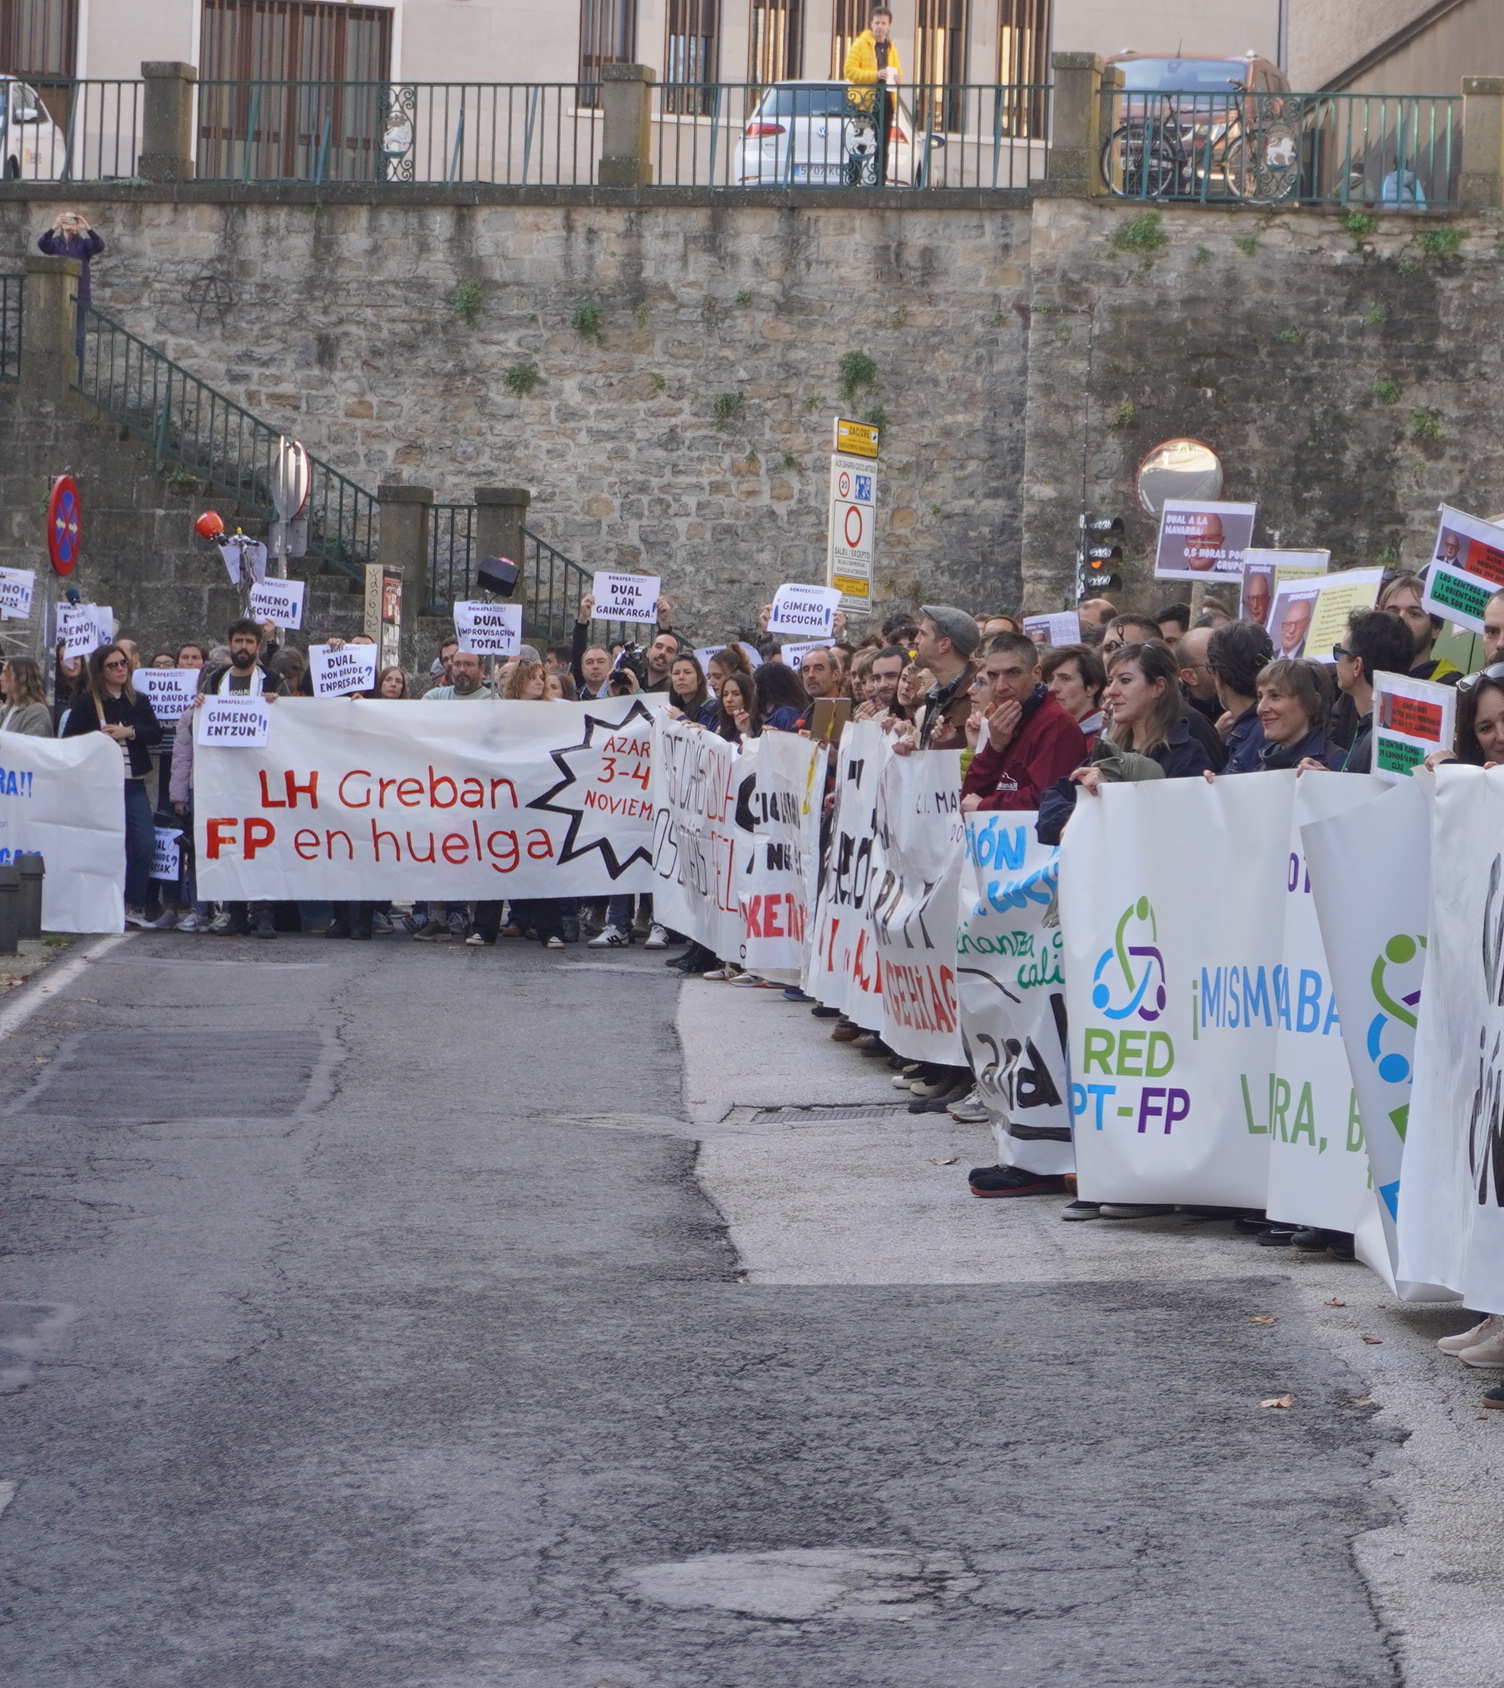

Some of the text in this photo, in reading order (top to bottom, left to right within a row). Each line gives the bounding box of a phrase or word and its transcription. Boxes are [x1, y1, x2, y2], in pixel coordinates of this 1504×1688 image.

[1188, 516, 1195, 524] A
[1197, 516, 1208, 525] LA
[611, 584, 642, 597] DUAL
[1440, 572, 1451, 584] LOS
[1453, 577, 1481, 595] CENTROS
[251, 592, 289, 607] GIMENO
[615, 597, 634, 606] LAN
[1433, 591, 1449, 604] CADA
[1451, 596, 1463, 609] 500
[1445, 585, 1487, 607] ORIENTADOR/
[252, 605, 289, 619] SCUCHA
[783, 601, 823, 612] GIMENO
[473, 615, 505, 627] DUAL
[780, 614, 823, 626] ESCUCHA
[470, 639, 504, 649] TOTAL
[327, 654, 357, 669] DUAL
[321, 671, 338, 681] NON
[339, 666, 363, 678] DAUDE
[149, 681, 182, 691] DUAL
[320, 675, 366, 693] ENPRESAK
[147, 694, 189, 702] ON DAUDE
[208, 711, 258, 724] GIMENO
[207, 726, 257, 736] ENTZUN
[603, 735, 651, 759] AZAR
[597, 757, 651, 791] 3-4
[259, 765, 519, 809] LH Greban
[584, 789, 655, 821] NOVIEM
[206, 817, 555, 873] FP en huelga
[1017, 946, 1066, 989] cali
[1083, 1028, 1175, 1077] RED
